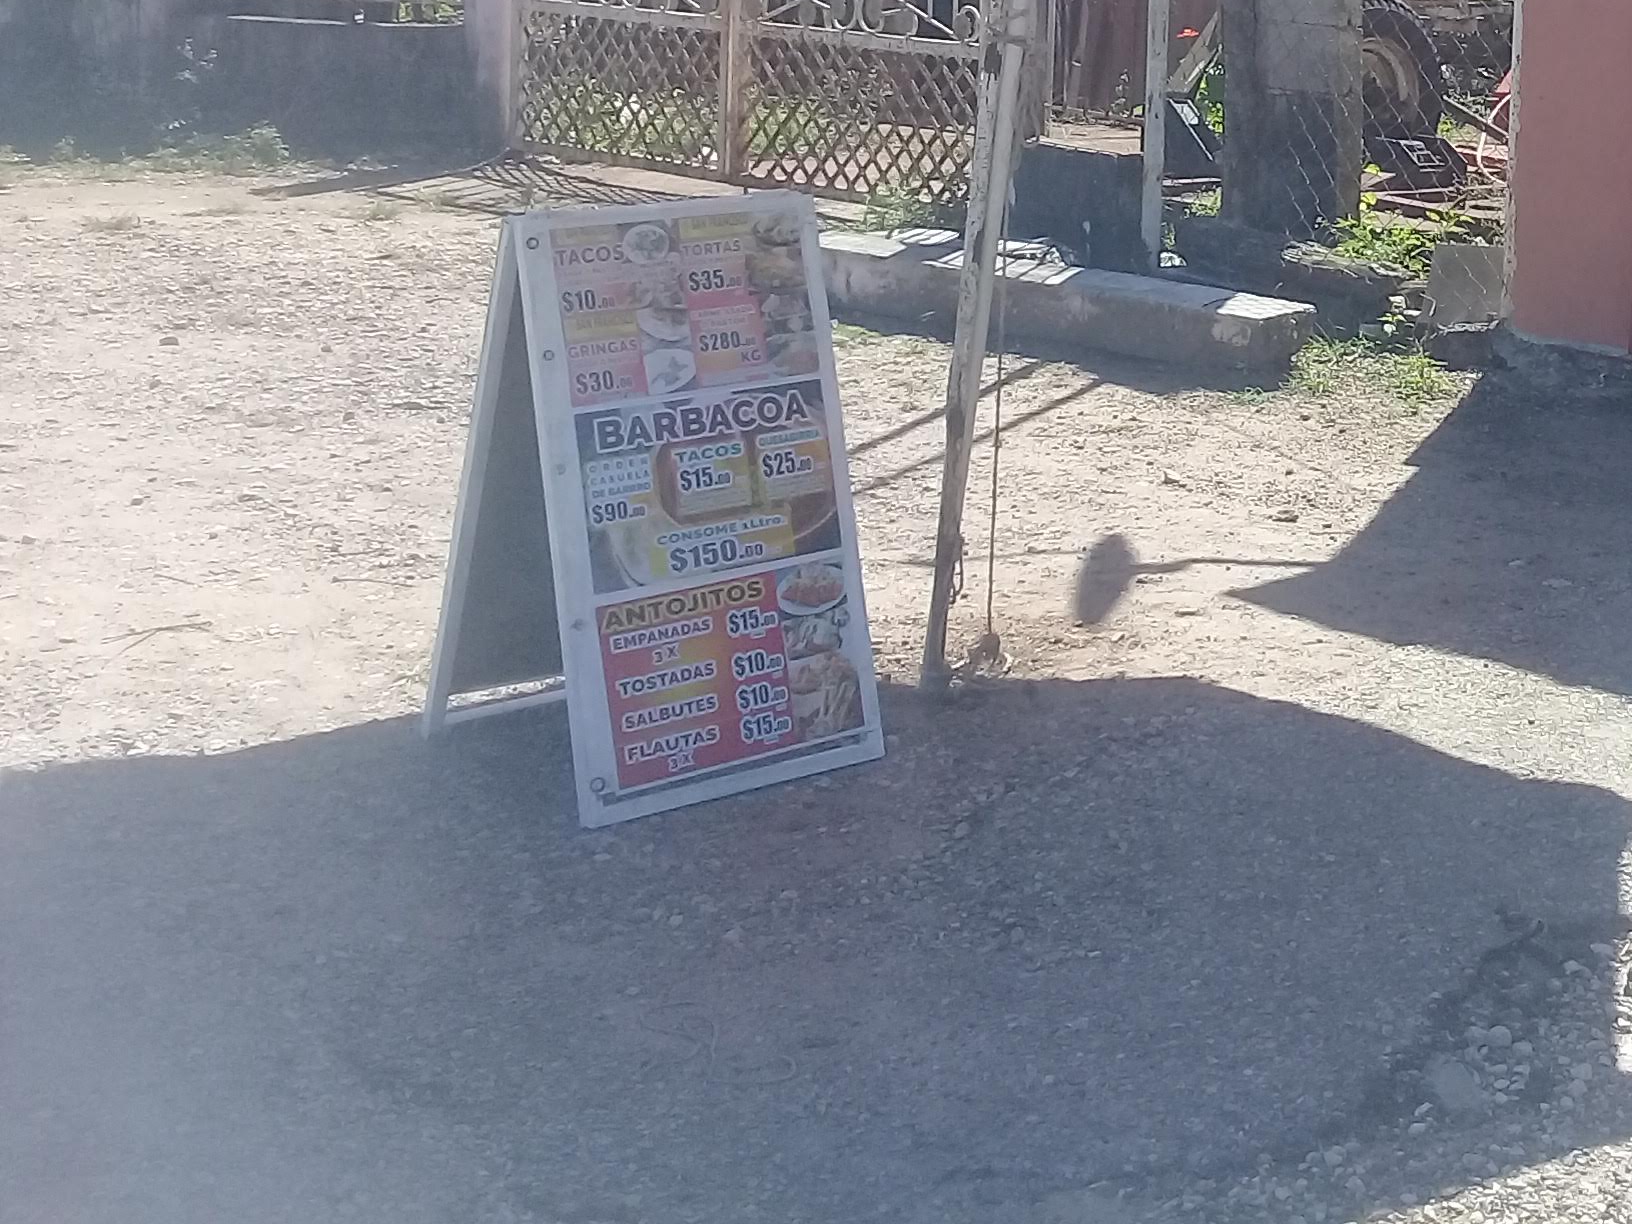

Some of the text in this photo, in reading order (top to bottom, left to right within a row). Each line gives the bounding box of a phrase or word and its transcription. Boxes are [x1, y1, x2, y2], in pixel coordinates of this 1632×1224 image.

[555, 244, 626, 266] TACOS
[682, 240, 741, 257] TORTAS
[568, 339, 638, 359] GRINGAS
[741, 349, 761, 362] KG
[598, 390, 808, 451] BARBACOA
[674, 443, 742, 463] TACOS
[657, 522, 738, 545] CONSOME
[670, 539, 763, 573] $150.00
[604, 580, 764, 631] ANTOJITOS
[612, 619, 711, 650] EMPANADAS
[618, 662, 714, 696] TOSTADAS
[624, 696, 717, 729] SALBUTES
[628, 727, 718, 762] FLAUTAS
